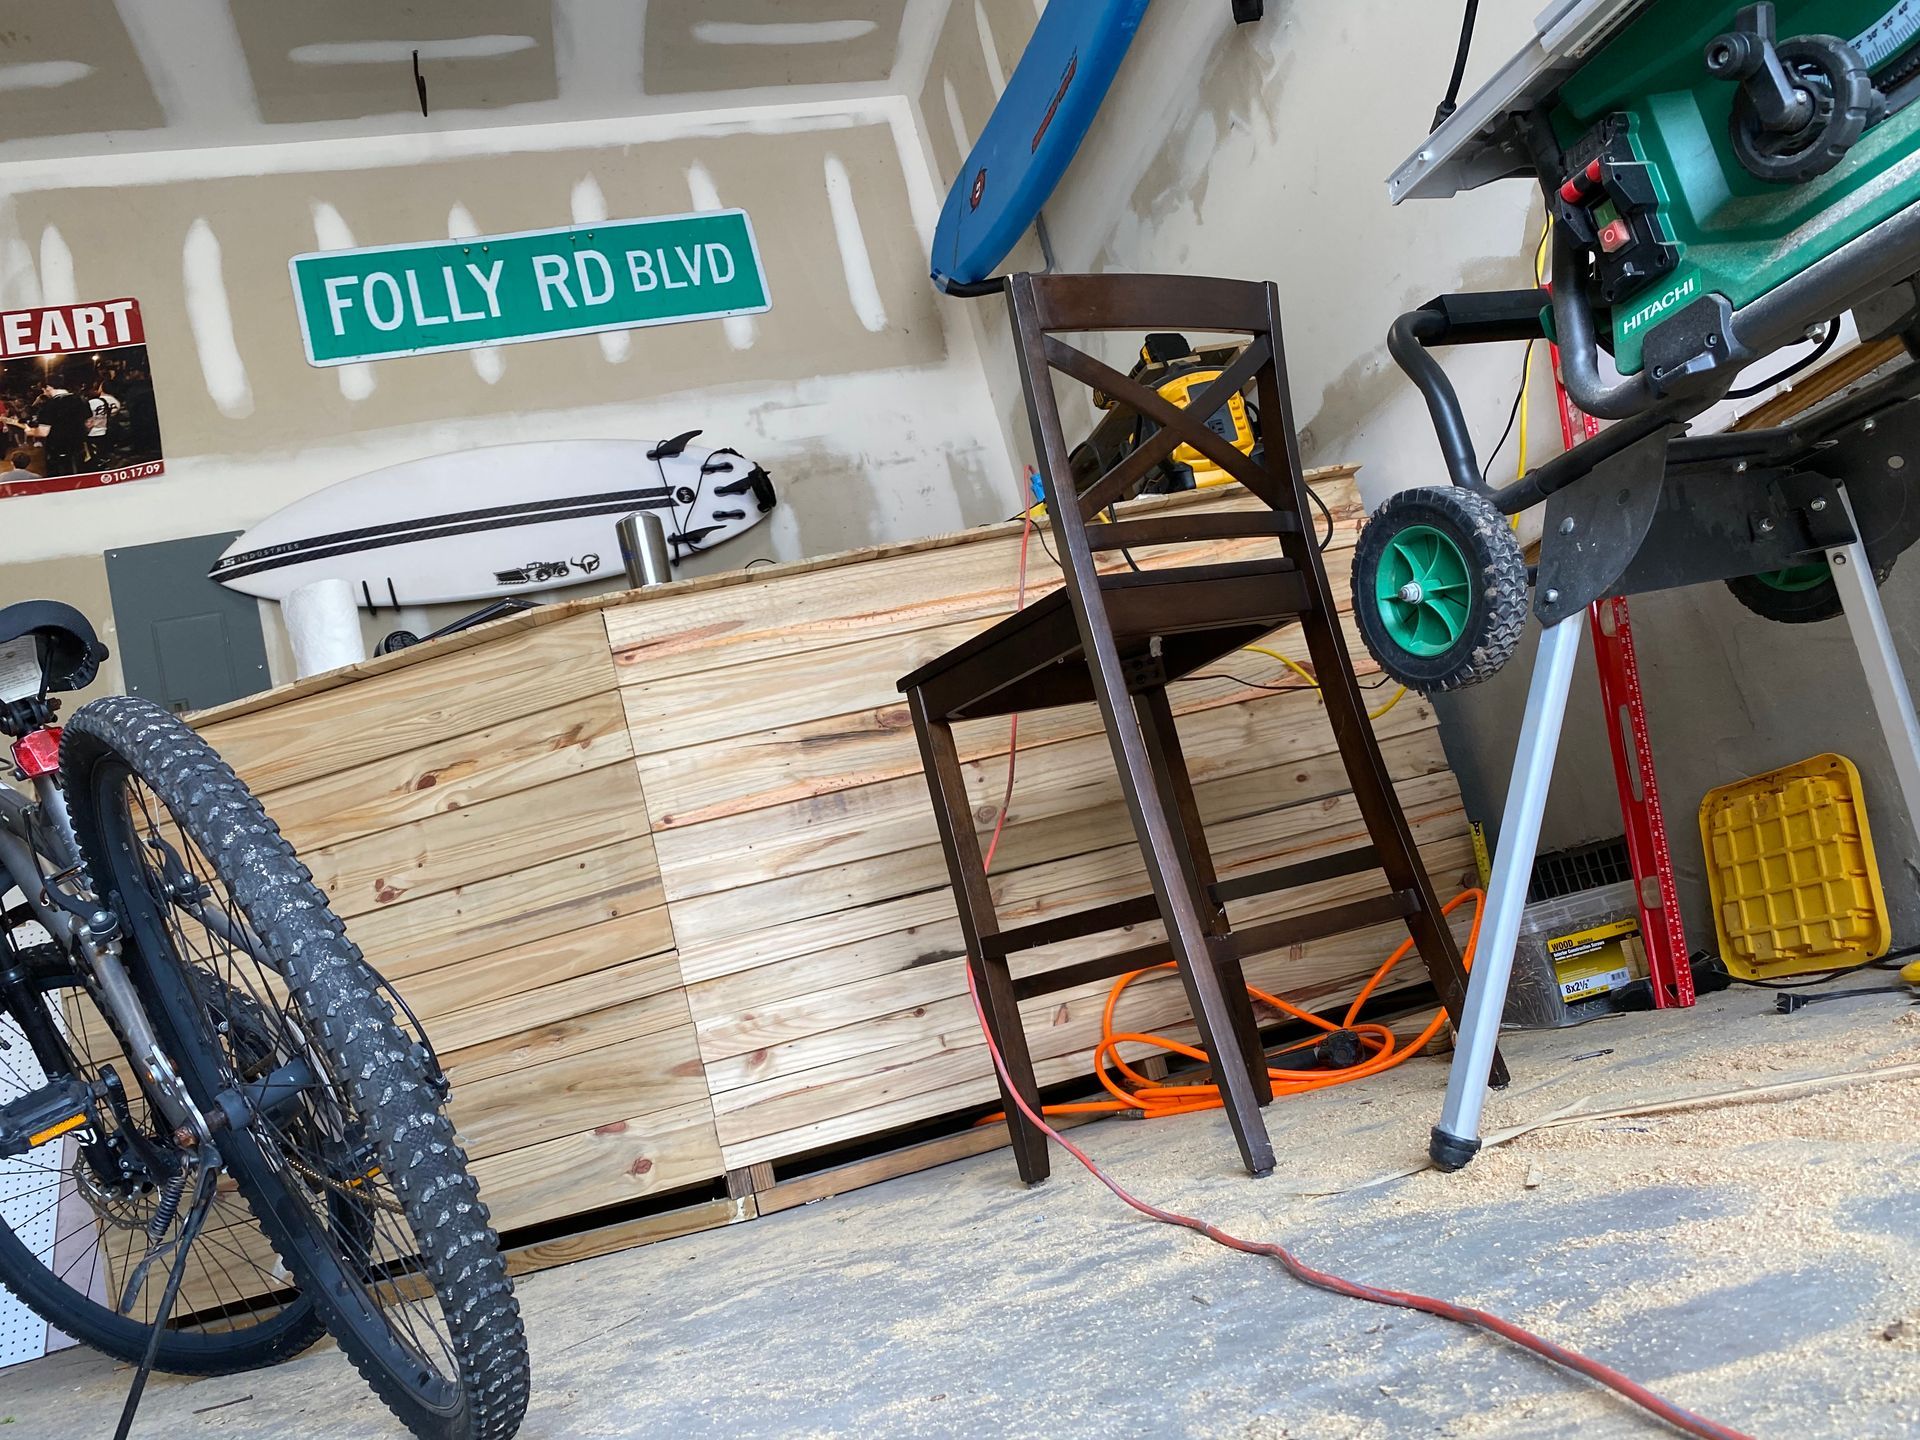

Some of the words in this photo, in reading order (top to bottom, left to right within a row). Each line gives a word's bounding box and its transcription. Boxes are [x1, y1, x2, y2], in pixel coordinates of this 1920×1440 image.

[324, 260, 504, 336] FOLLY
[532, 249, 615, 311] RD
[626, 242, 736, 293] BLVD
[1623, 277, 1694, 335] HITACHI
[0, 301, 133, 355] EART
[114, 463, 161, 482] 10.17.09
[238, 542, 300, 562] INDUSTRIES
[1551, 939, 1574, 952] WOOD
